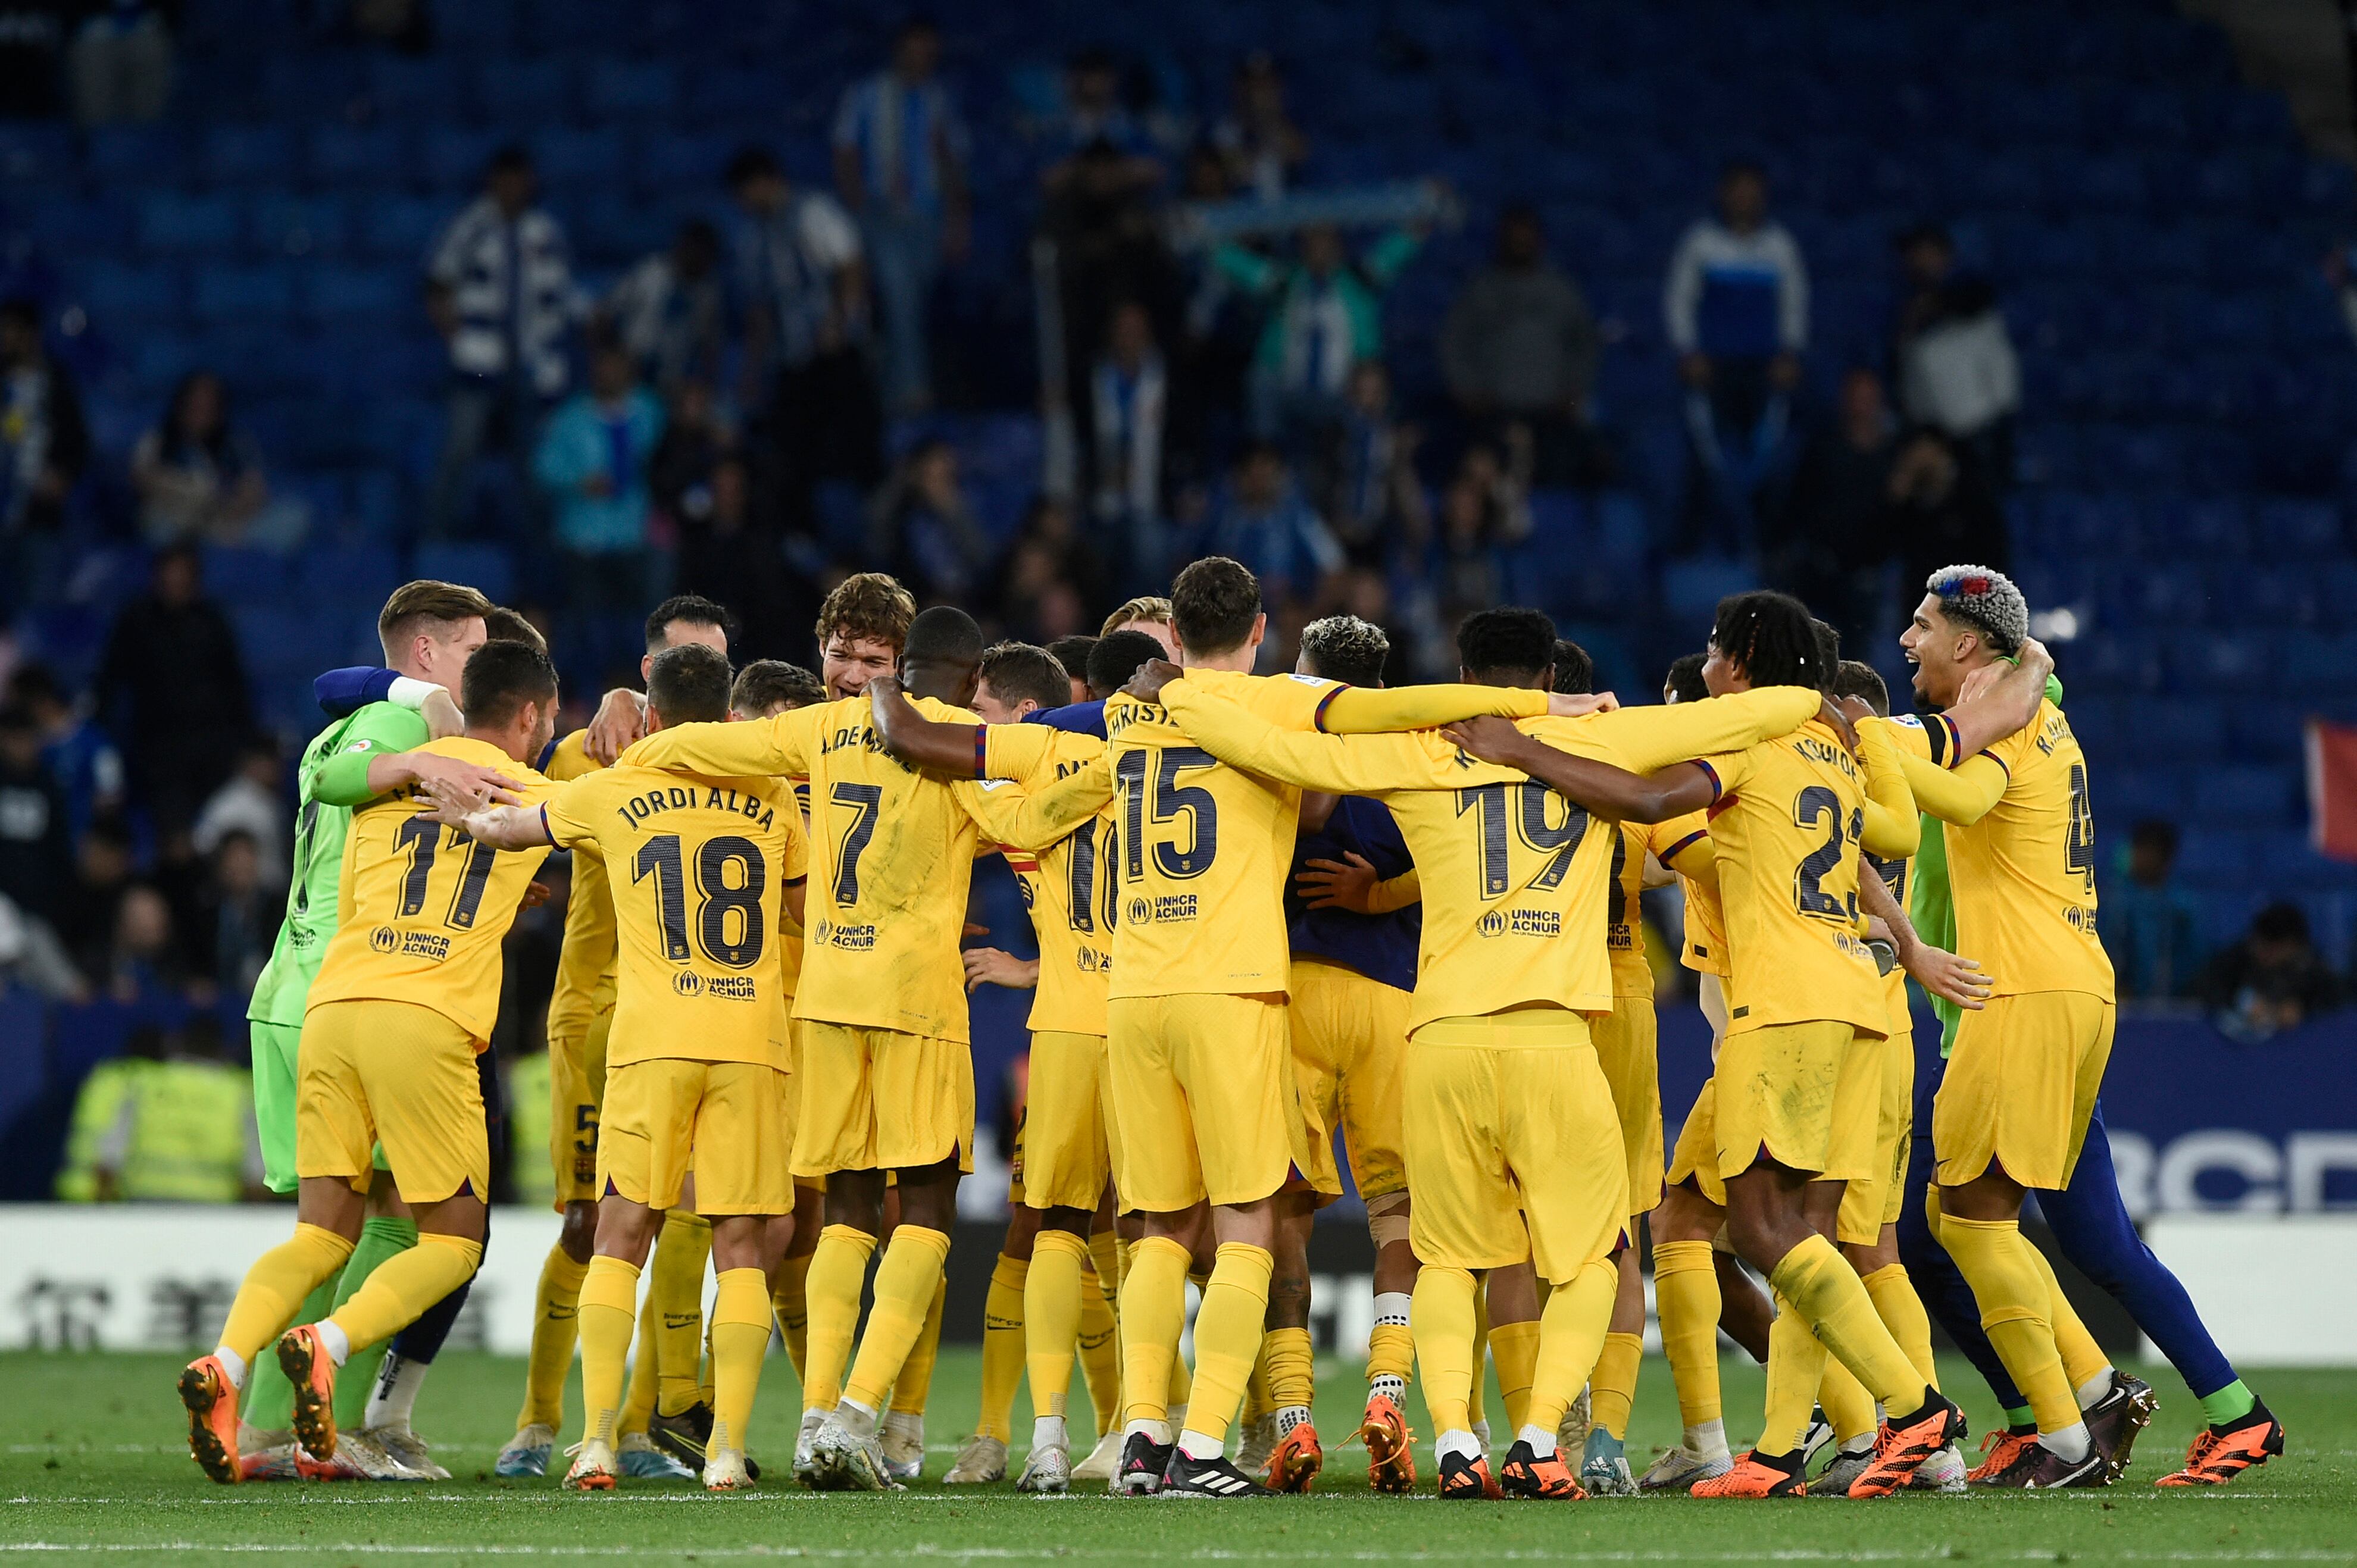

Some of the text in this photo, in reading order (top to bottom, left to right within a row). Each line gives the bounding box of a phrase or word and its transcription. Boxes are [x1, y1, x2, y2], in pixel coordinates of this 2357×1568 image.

[617, 787, 774, 833] JORDI ALBA
[1115, 747, 1217, 884] 15
[2065, 765, 2094, 894] 4
[830, 782, 882, 909] 7
[1455, 778, 1589, 901] 19
[392, 810, 496, 932] 11
[632, 835, 765, 970] 18
[1155, 894, 1198, 907] UNHCR
[1155, 906, 1197, 919] ACNUR
[1511, 909, 1560, 922] UNHCR
[836, 925, 875, 936] UNHCR
[1511, 921, 1561, 934] ACNUR
[1608, 925, 1631, 935] HCR
[405, 931, 451, 949] UNHCR
[831, 935, 874, 947] ACNUR
[1607, 935, 1631, 947] NUR
[402, 943, 447, 959] ACNUR
[706, 977, 755, 988] UNHCR
[709, 985, 756, 998] ACNUR
[573, 1104, 599, 1156] 5
